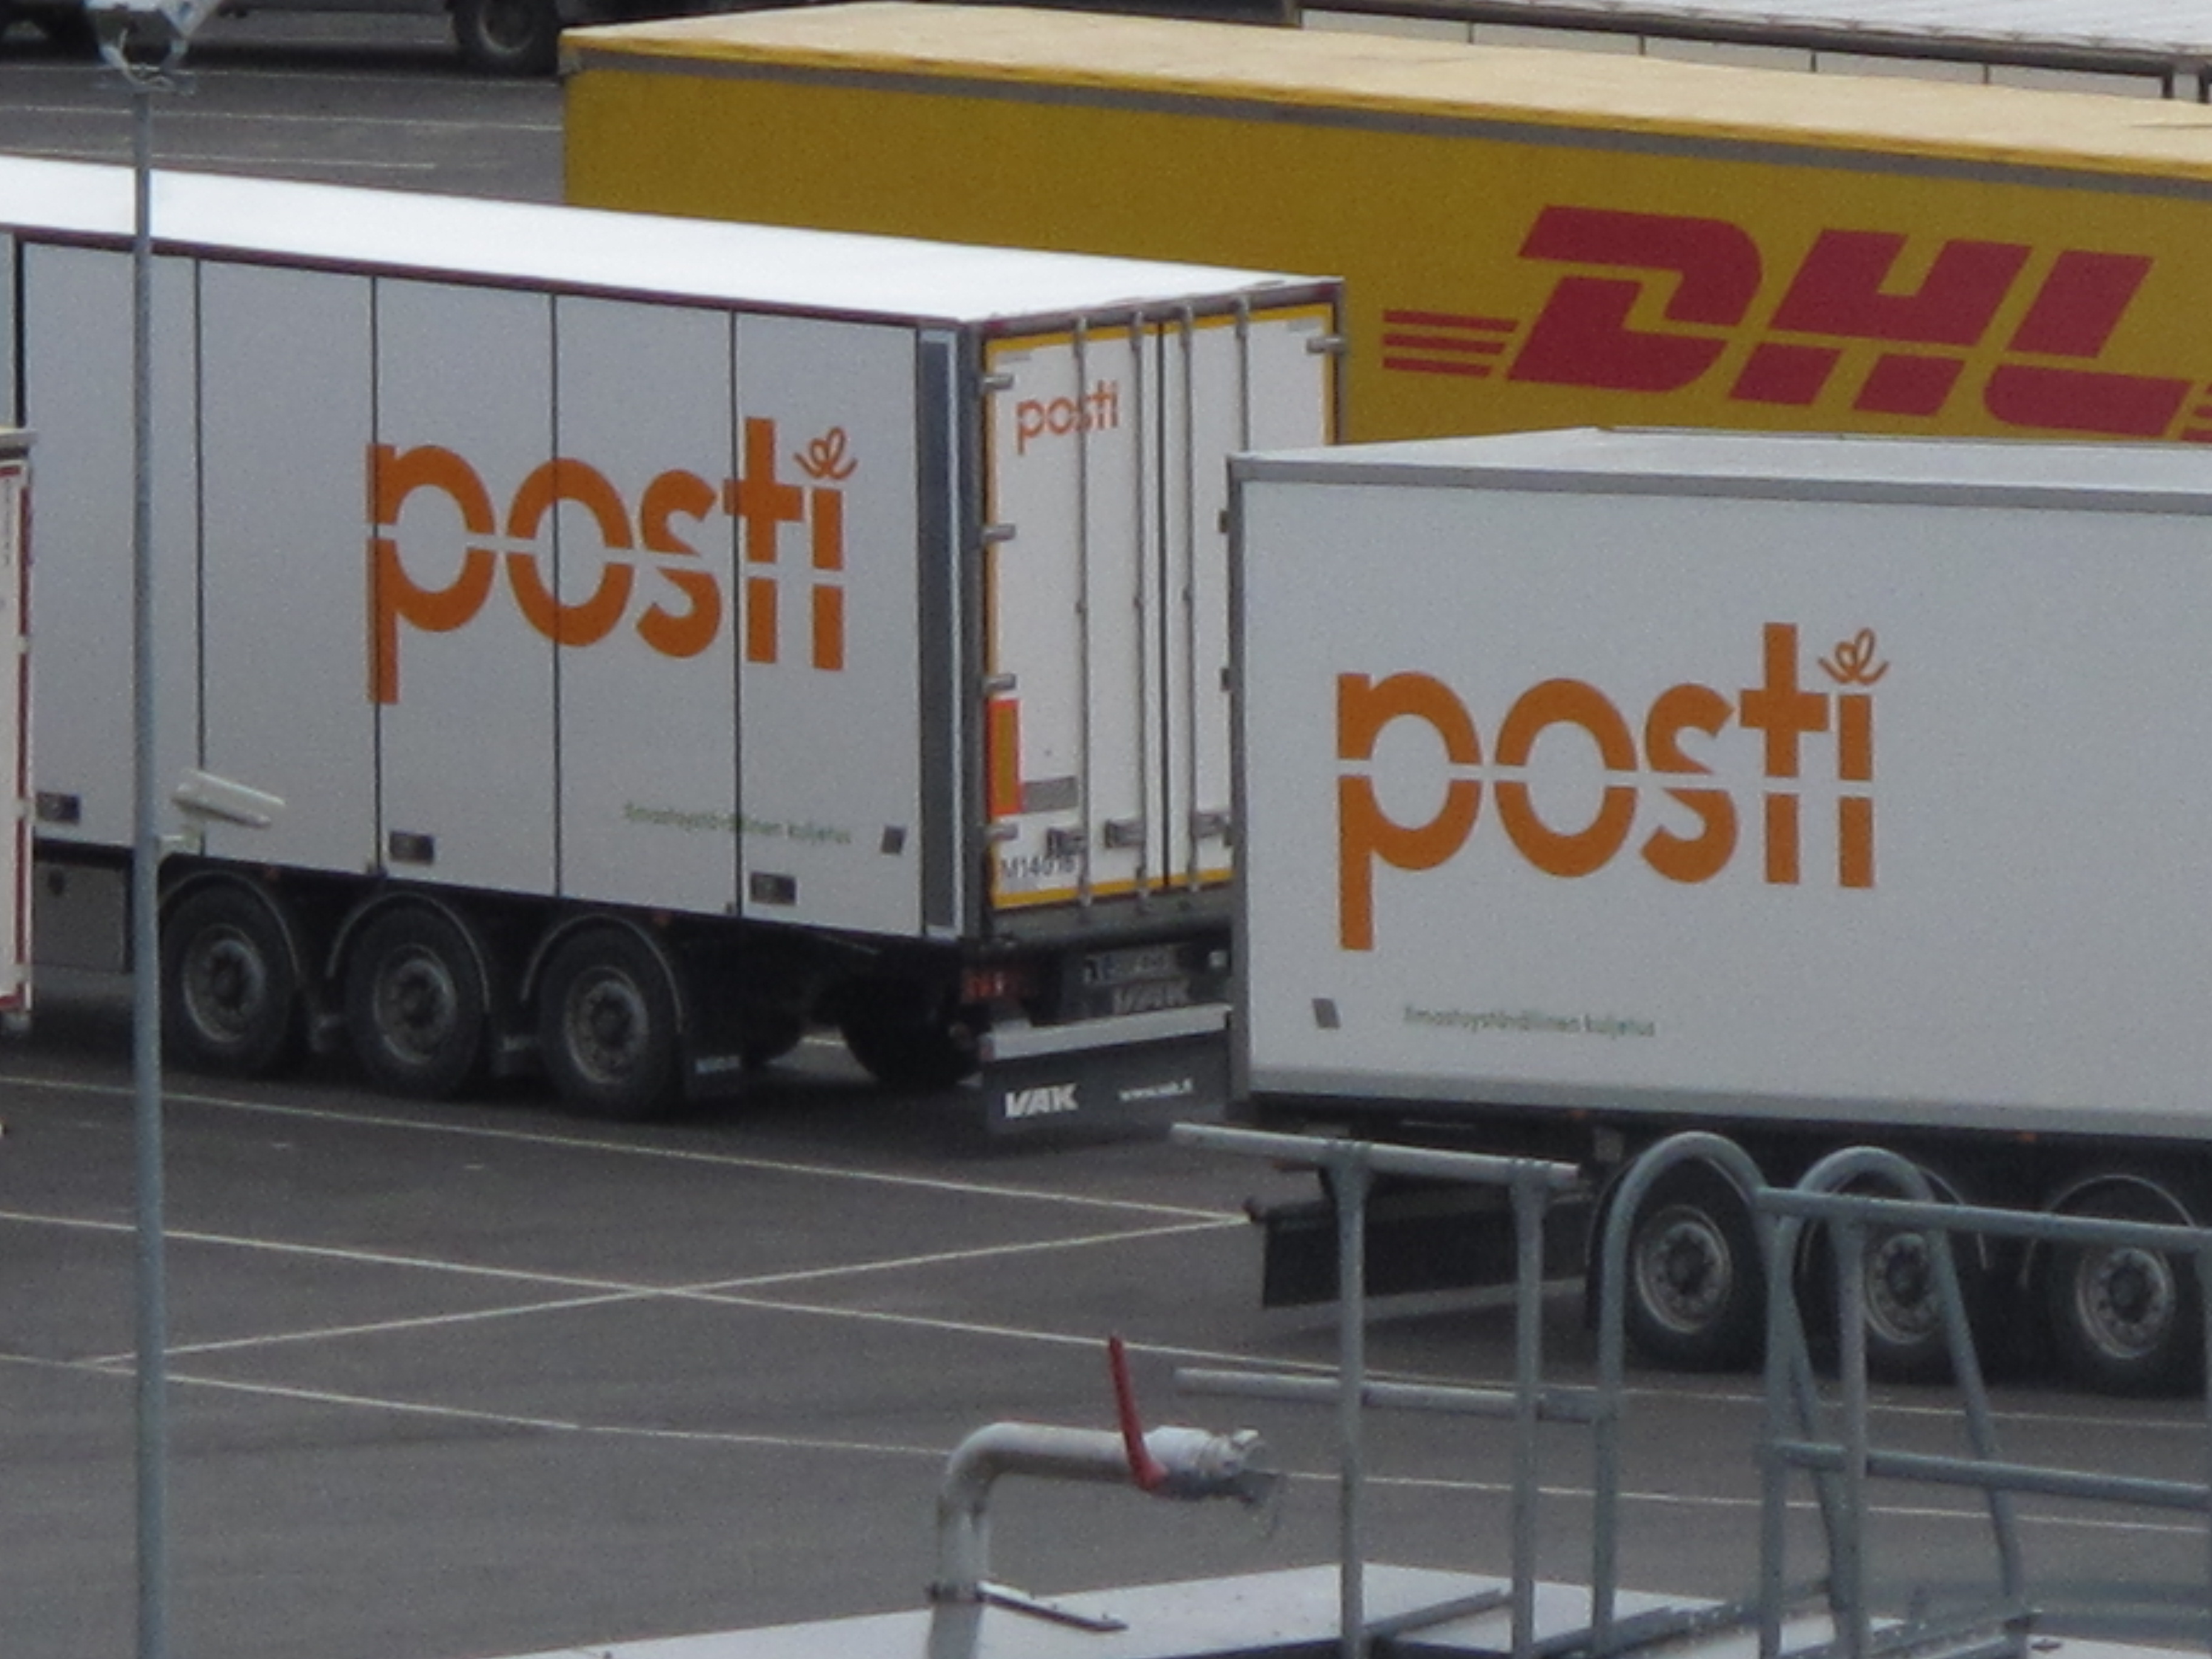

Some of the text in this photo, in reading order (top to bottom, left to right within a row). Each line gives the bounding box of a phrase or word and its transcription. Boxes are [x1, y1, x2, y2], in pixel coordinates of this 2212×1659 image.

[1016, 380, 1118, 455] posti
[1506, 204, 2194, 438] DHL
[367, 417, 857, 705] posti
[1337, 623, 1889, 951] posti
[1005, 1083, 1079, 1118] VAK
